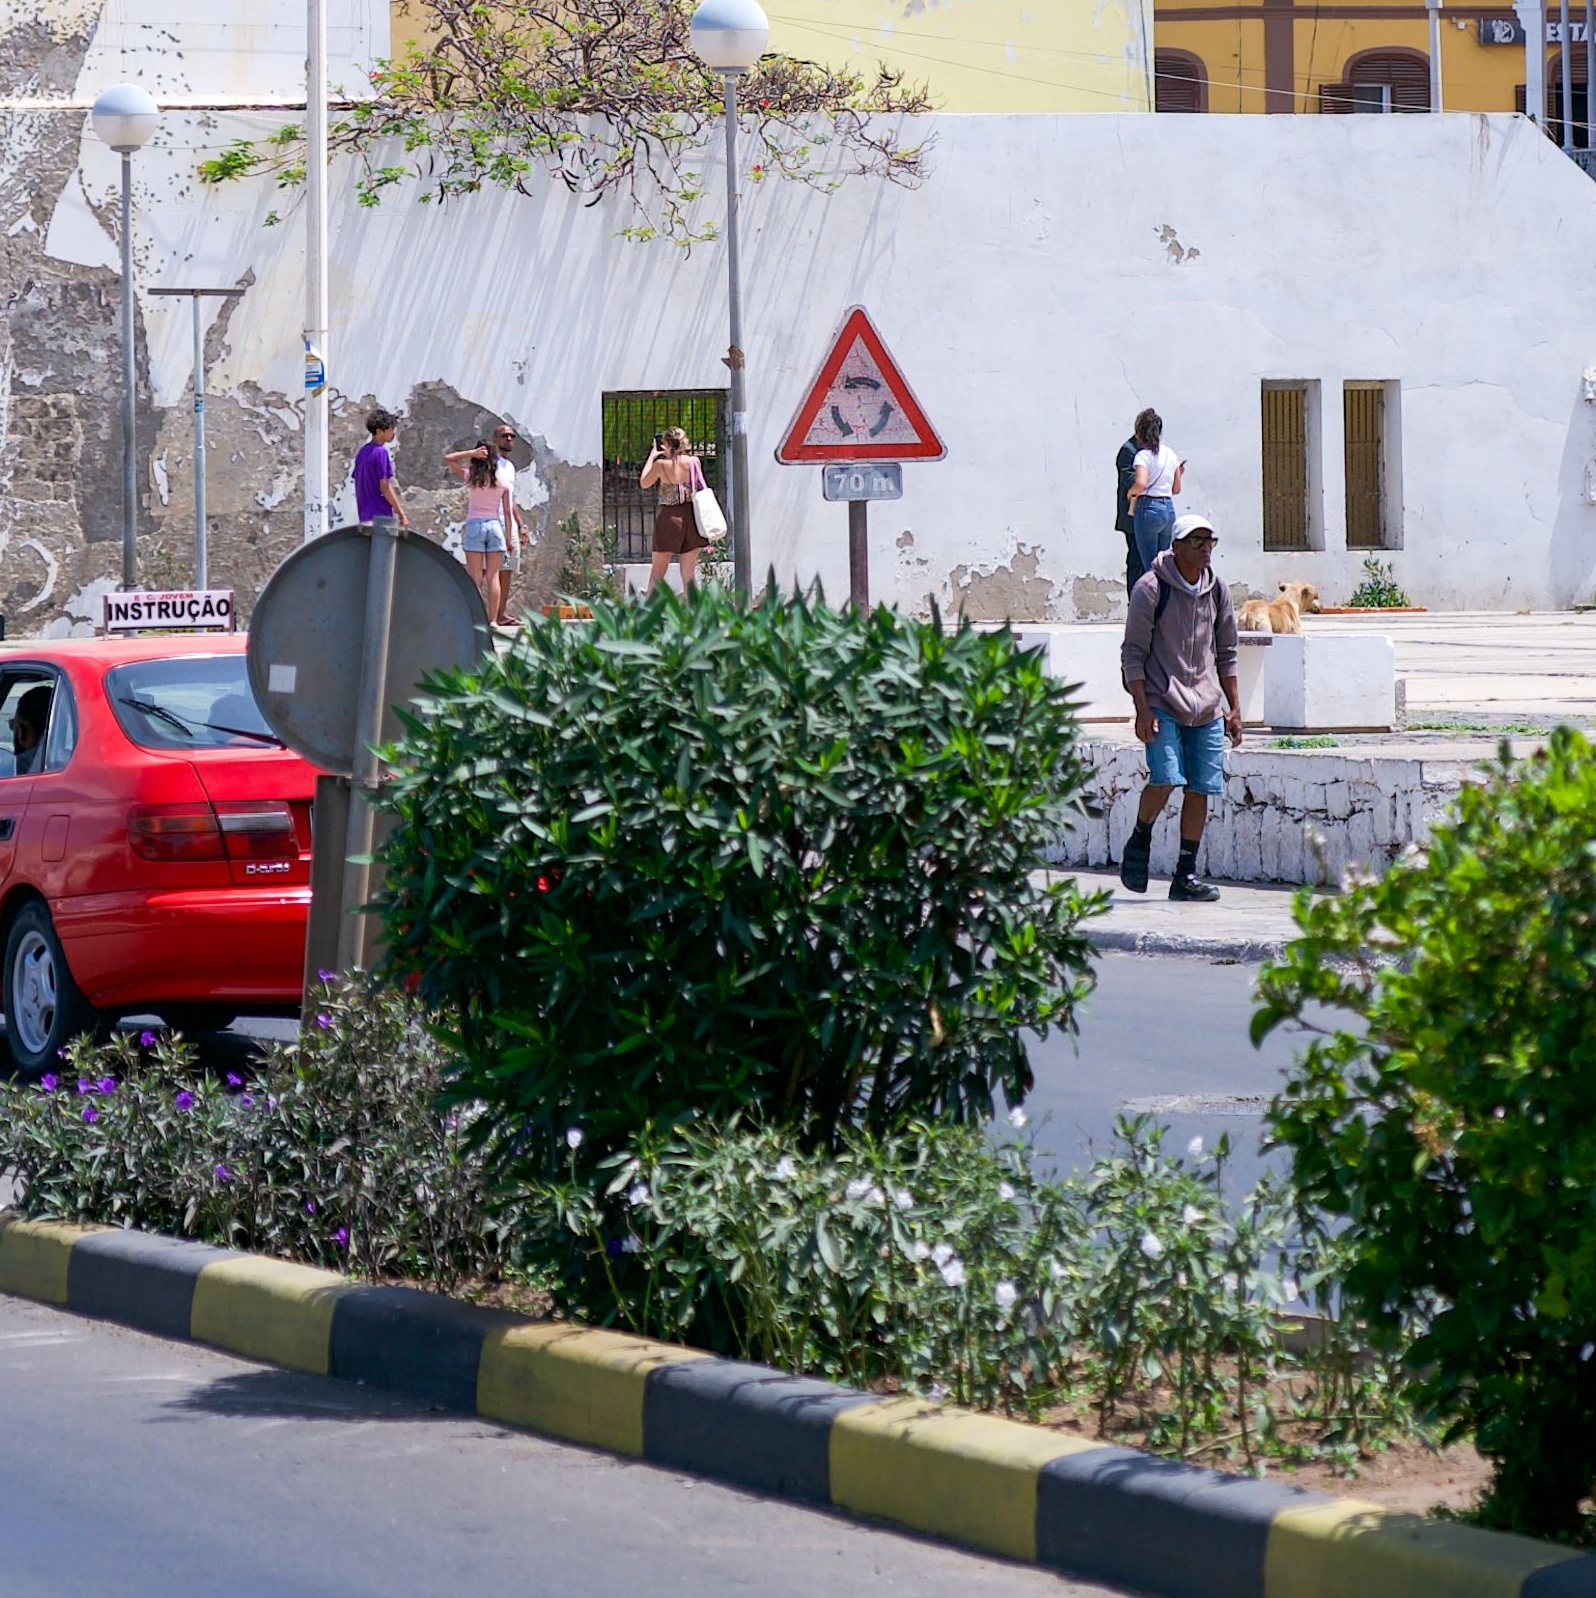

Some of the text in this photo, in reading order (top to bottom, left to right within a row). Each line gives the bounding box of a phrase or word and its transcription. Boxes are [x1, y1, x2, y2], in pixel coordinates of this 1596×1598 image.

[833, 473, 896, 493] 70 m
[107, 594, 231, 623] INSTRUÇÃO
